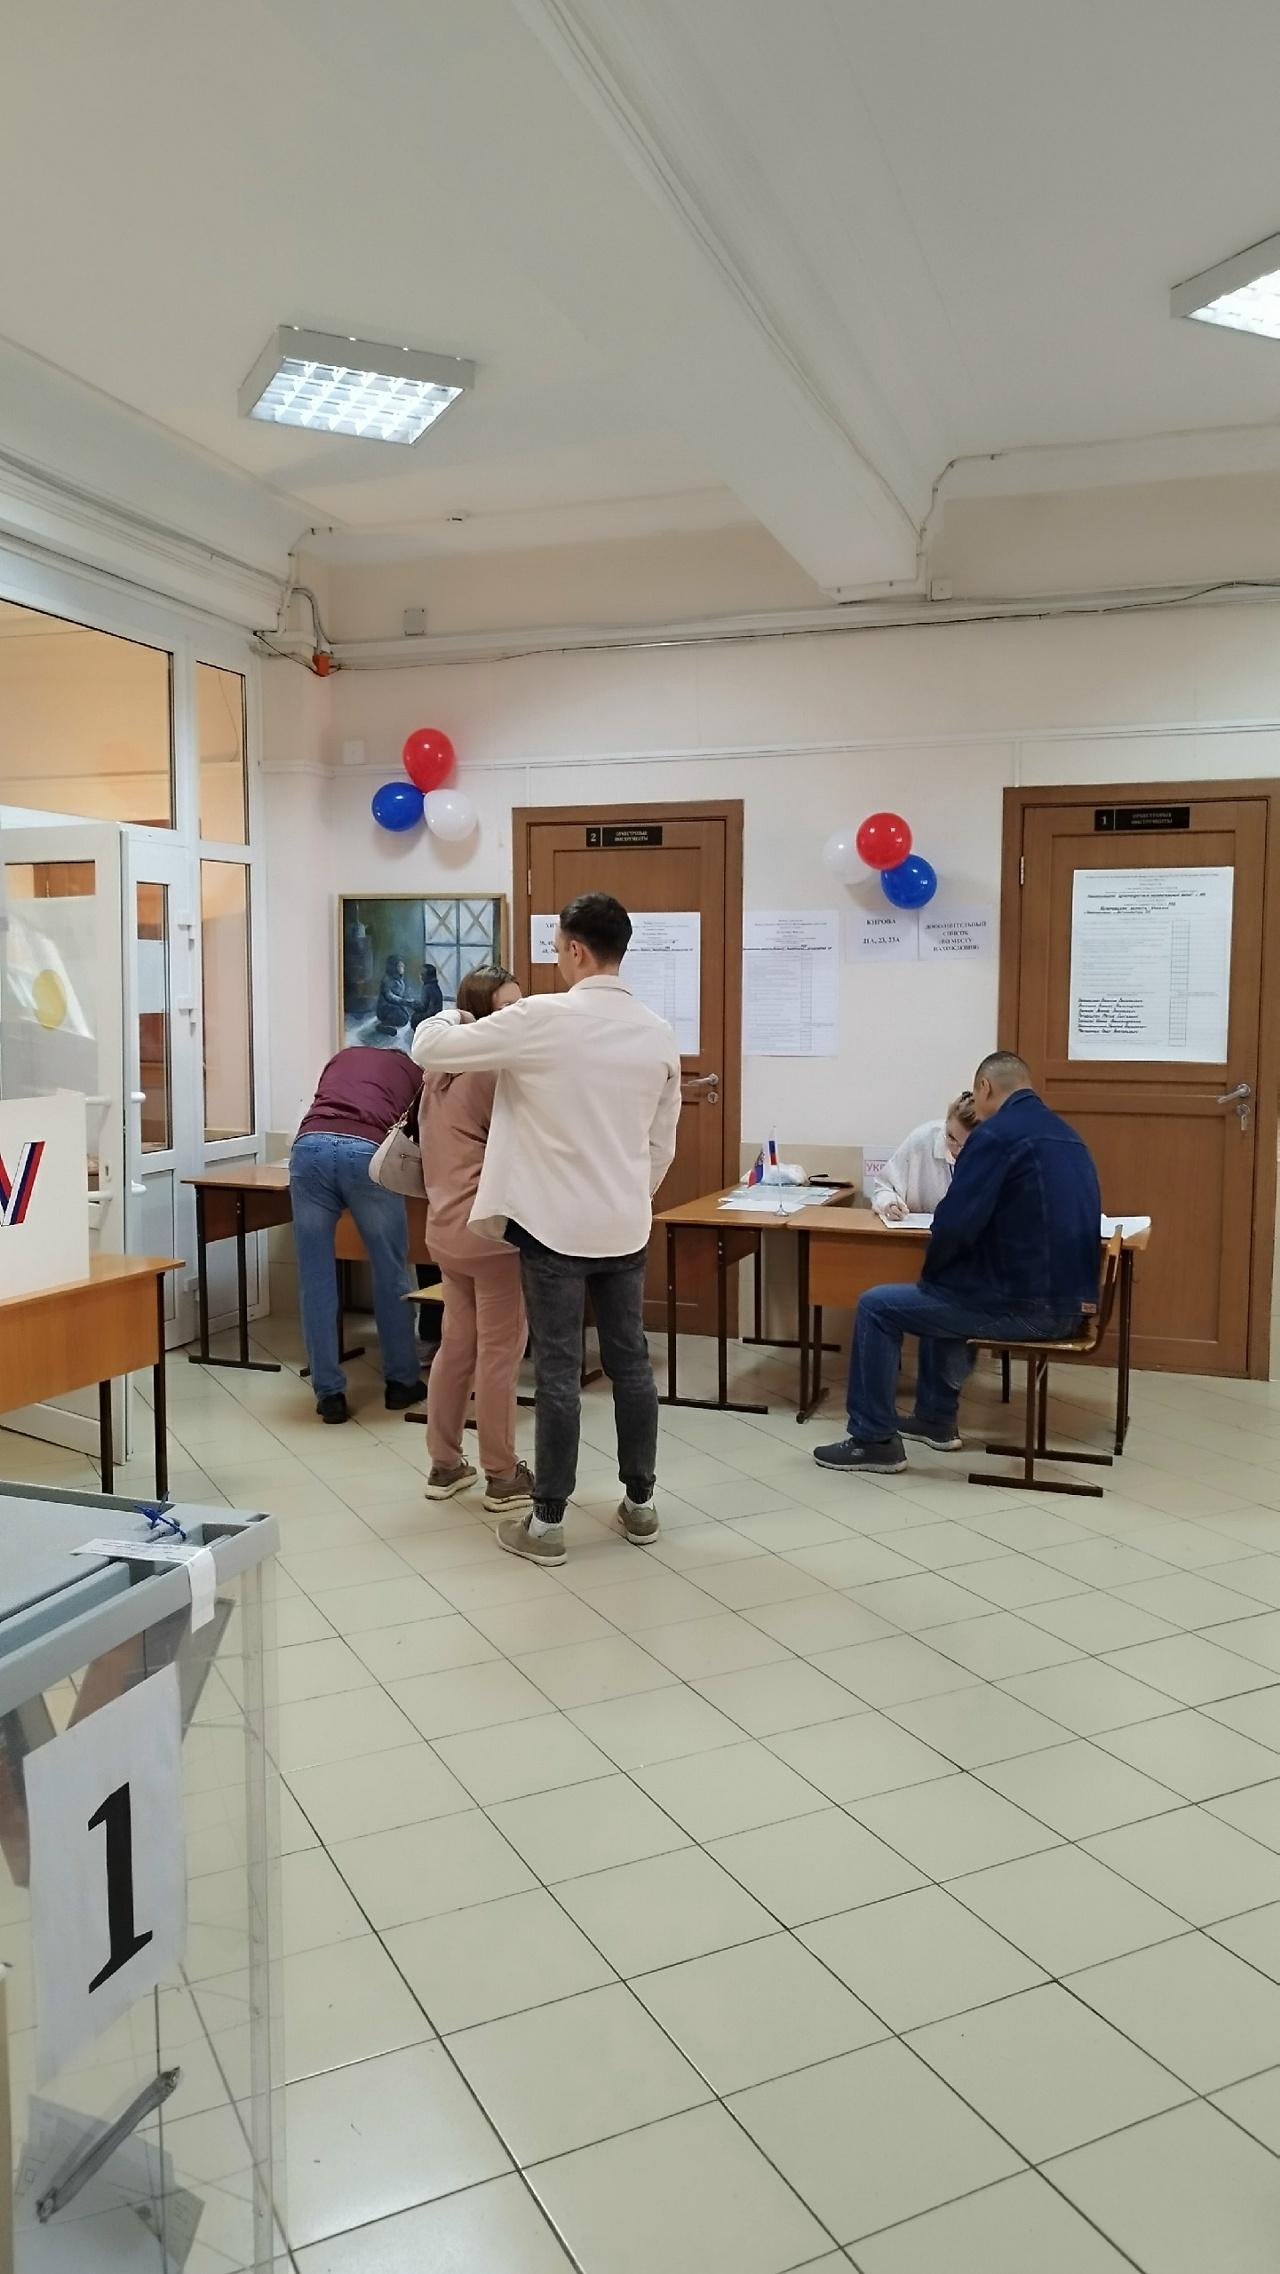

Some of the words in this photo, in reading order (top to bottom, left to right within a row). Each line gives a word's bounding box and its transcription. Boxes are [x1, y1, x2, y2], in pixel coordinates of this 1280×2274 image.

[1102, 816, 1107, 825] 1
[590, 833, 597, 842] 2
[87, 1781, 154, 1995] 1
